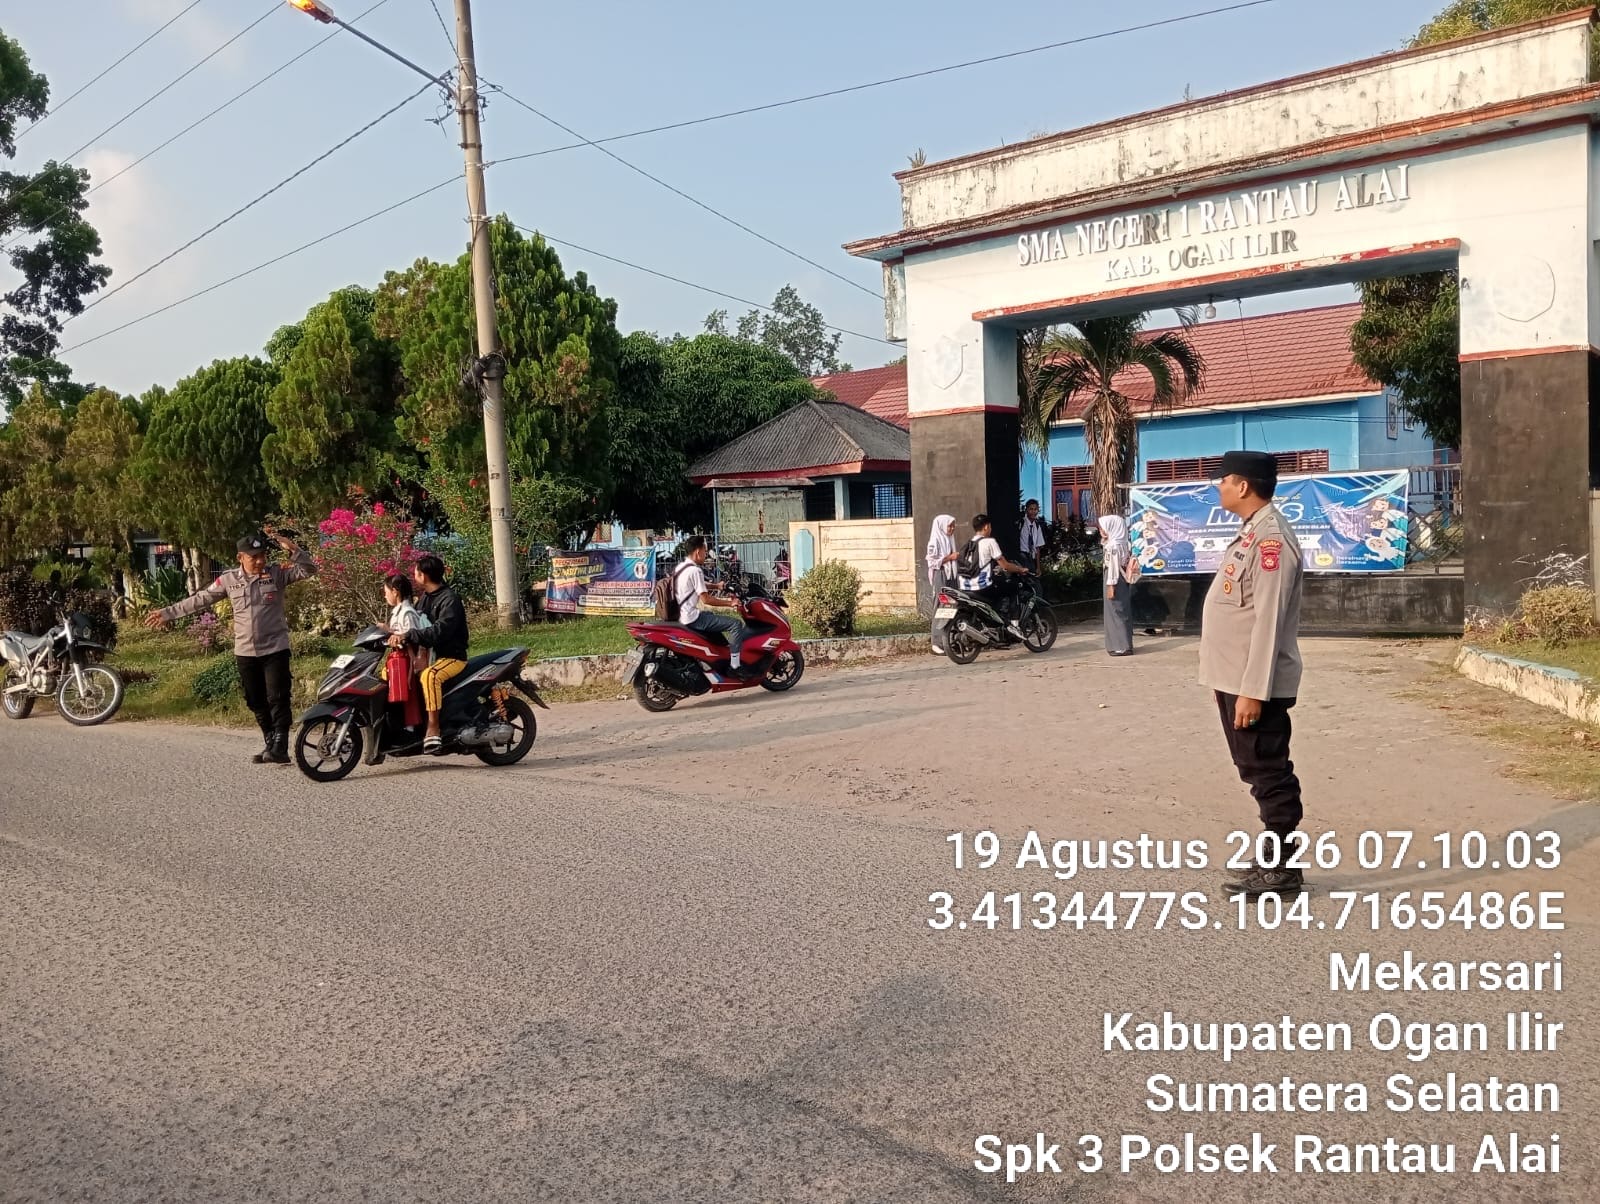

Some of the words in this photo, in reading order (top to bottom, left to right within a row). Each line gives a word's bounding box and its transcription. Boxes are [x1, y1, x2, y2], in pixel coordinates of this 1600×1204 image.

[1017, 229, 1069, 266] SMA
[1076, 209, 1172, 256] NEGERI
[1179, 204, 1192, 238] 1
[1199, 179, 1319, 234] RANTAU
[1334, 164, 1411, 212] ALAI
[1105, 255, 1160, 282] KAB.
[1168, 236, 1235, 272] OGAN
[1243, 229, 1299, 259] ILIR
